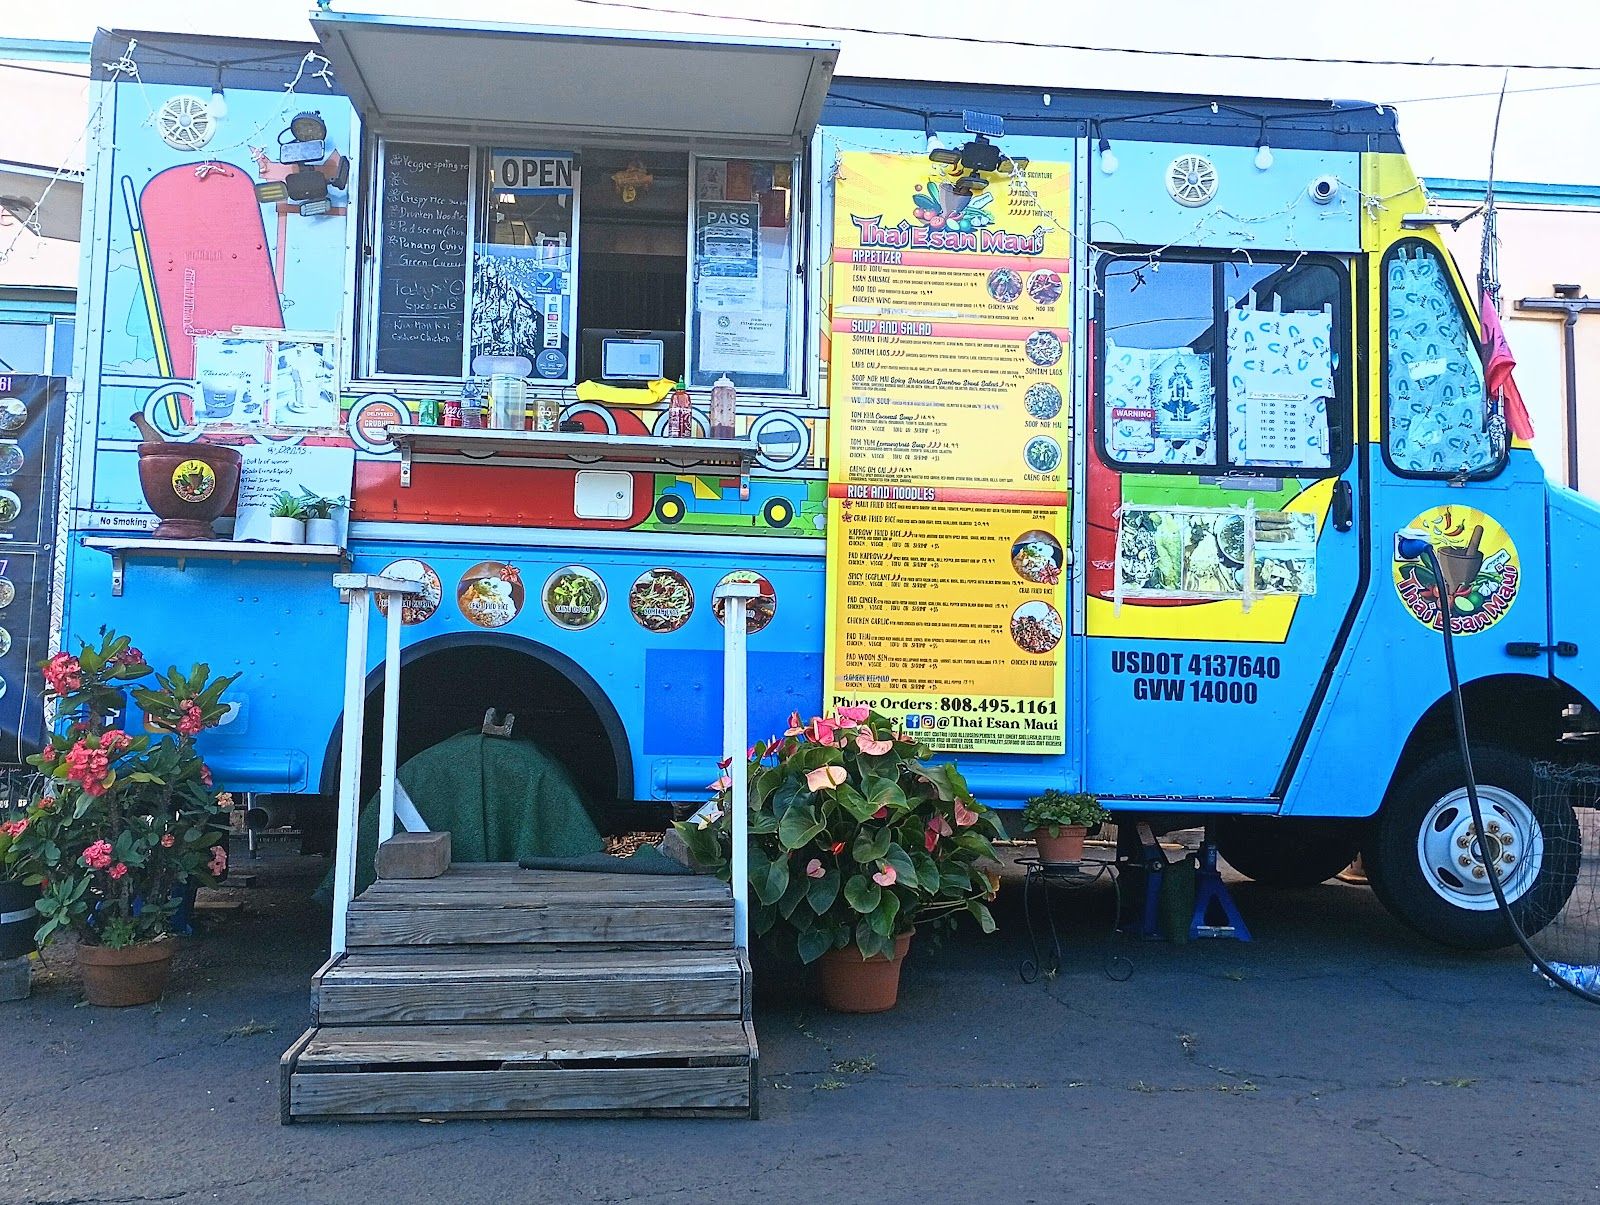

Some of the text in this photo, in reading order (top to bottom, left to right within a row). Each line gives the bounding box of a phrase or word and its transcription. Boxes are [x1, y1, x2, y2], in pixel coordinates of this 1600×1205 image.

[502, 158, 572, 187] OPEN
[707, 212, 750, 225] PASS
[850, 213, 1044, 254] Thai Esan Maui
[400, 236, 436, 254] Panang
[852, 250, 902, 264] APPETIZER
[852, 320, 932, 336] SOUP AND SALAD
[1116, 410, 1152, 418] WARNING
[848, 485, 935, 500] RICE AND NOODLES
[100, 516, 148, 528] No Smoking
[1398, 567, 1434, 622] Thai
[1482, 564, 1518, 619] Maui
[1112, 650, 1280, 679] USDOT 4137640
[1134, 678, 1258, 704] GVW 14000
[940, 697, 1058, 714] 808.495.1161
[937, 716, 982, 730] @Thai
[986, 717, 1020, 729] Esan
[1024, 718, 1058, 730] Maui
